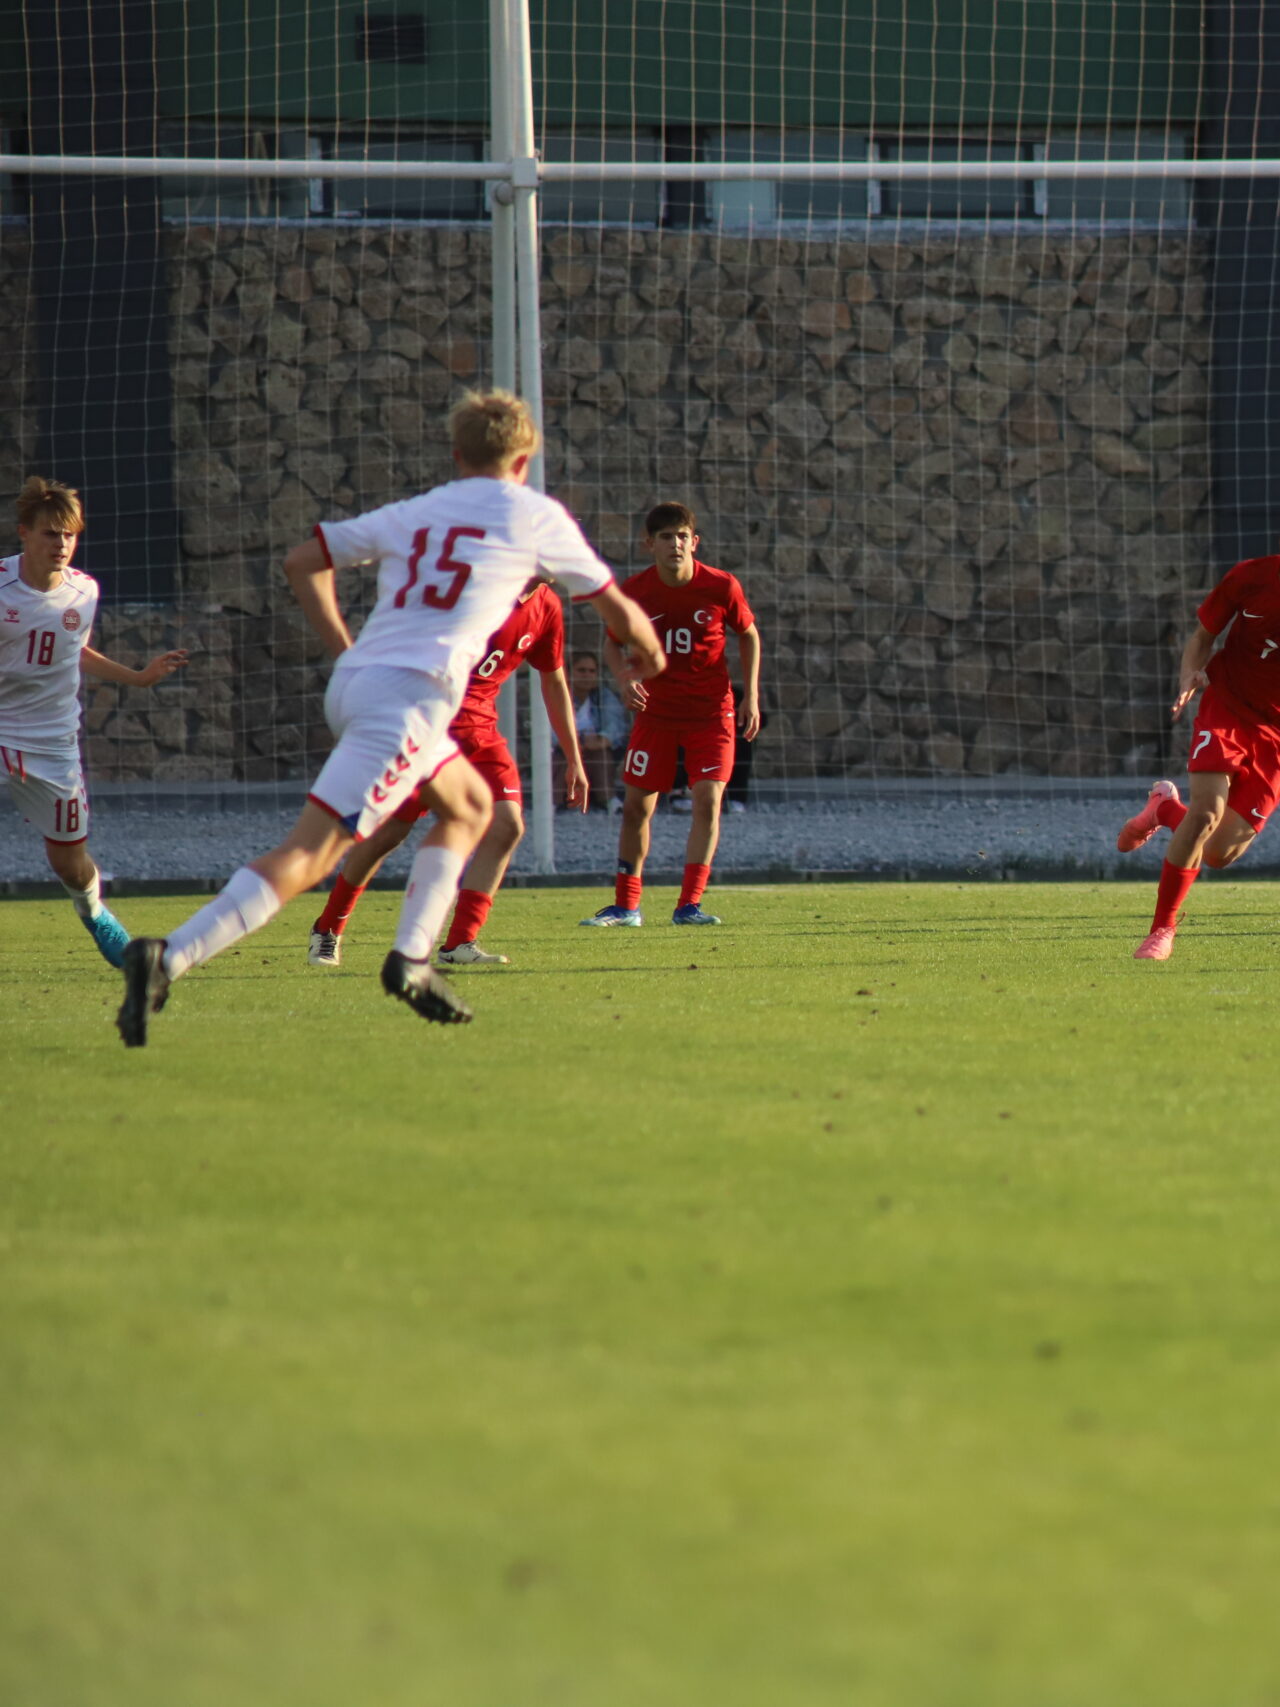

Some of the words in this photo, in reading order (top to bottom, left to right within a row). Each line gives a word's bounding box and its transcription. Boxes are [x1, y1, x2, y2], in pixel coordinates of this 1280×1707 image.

[393, 526, 486, 611] 15
[26, 629, 55, 665] 18
[665, 627, 691, 654] 19
[1260, 638, 1279, 660] 7
[1192, 730, 1212, 760] 7
[624, 748, 649, 777] 19
[55, 798, 79, 833] 18
